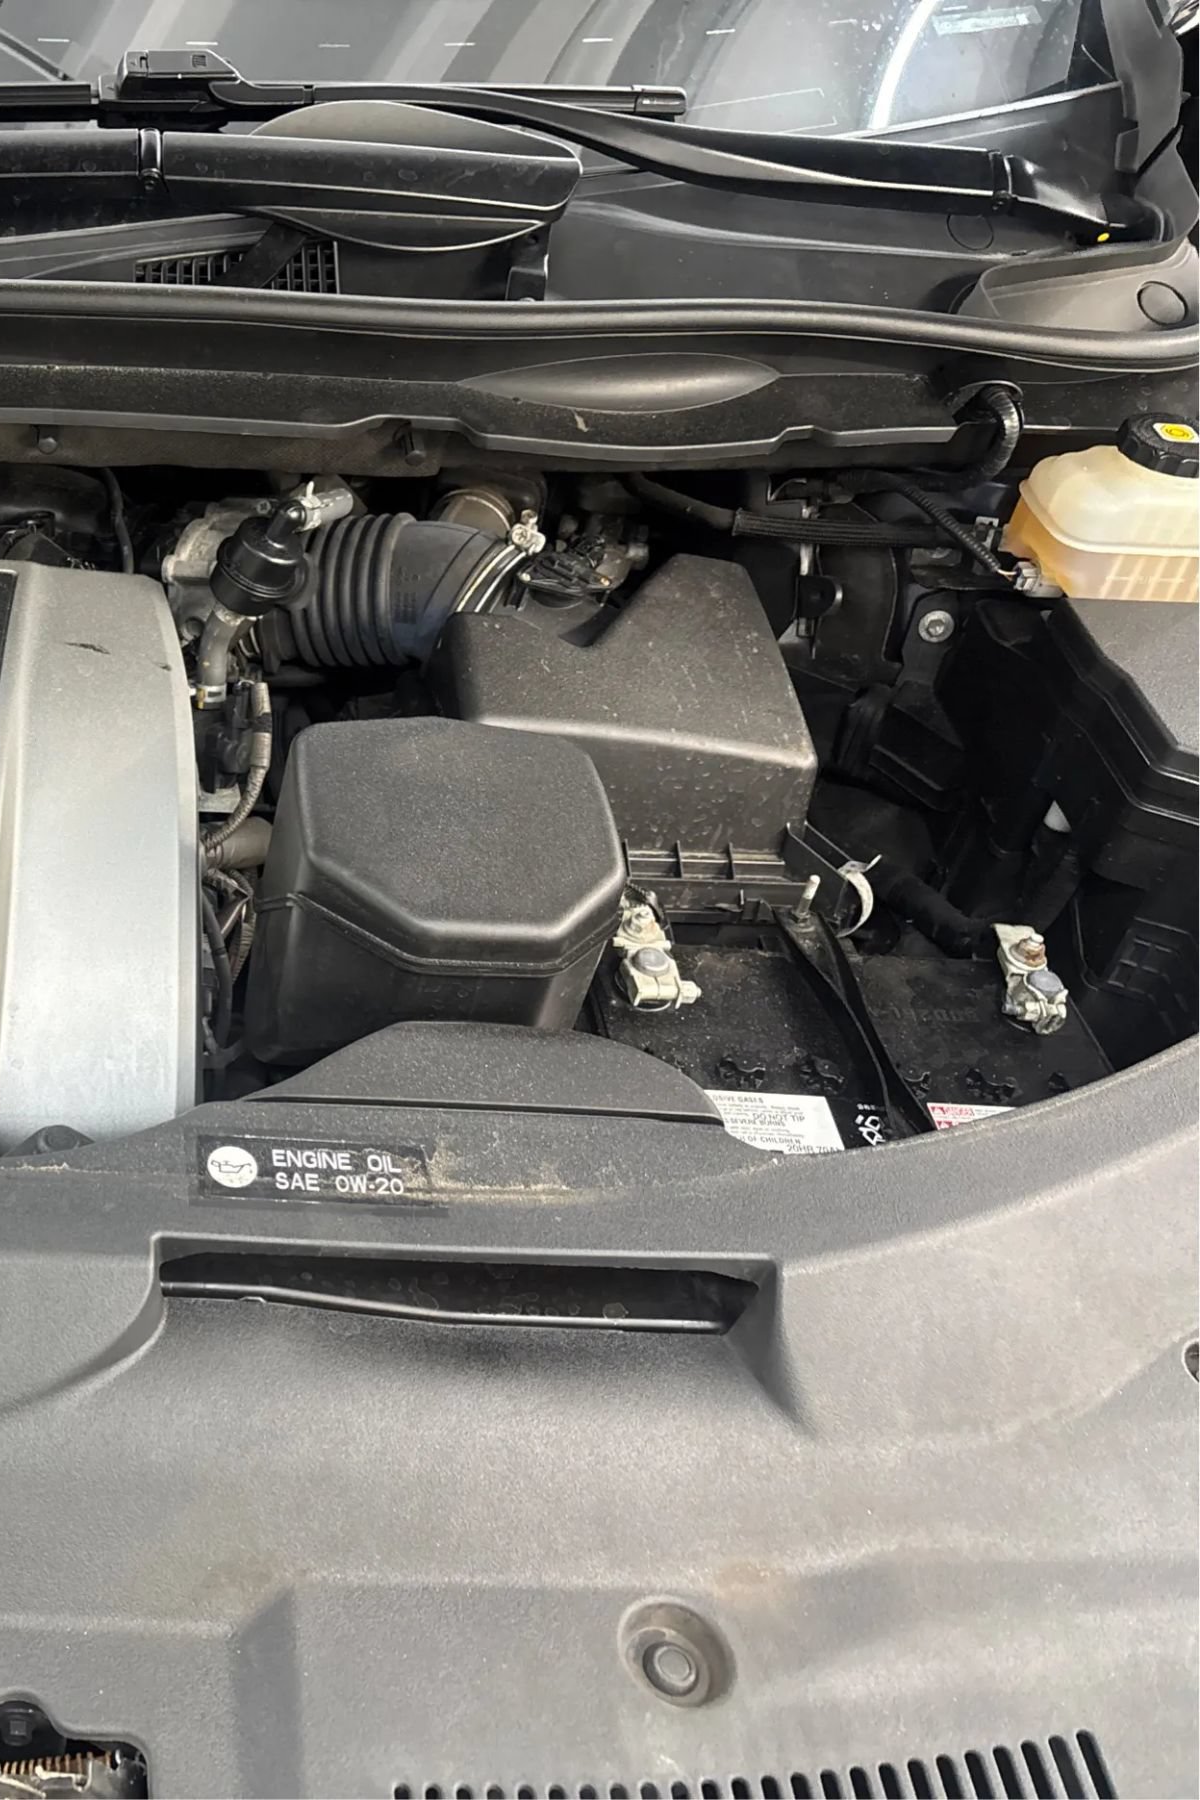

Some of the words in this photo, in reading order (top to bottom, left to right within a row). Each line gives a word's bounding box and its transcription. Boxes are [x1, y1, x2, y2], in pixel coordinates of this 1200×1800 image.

[752, 1112, 767, 1121] DO
[769, 1113, 789, 1122] NOT
[791, 1114, 806, 1123] TIP
[760, 1136, 802, 1146] CHILDREN
[271, 1149, 352, 1170] ENGINE
[367, 1154, 402, 1173] OIL
[275, 1173, 320, 1192] SAE
[335, 1177, 404, 1195] 0W-20
